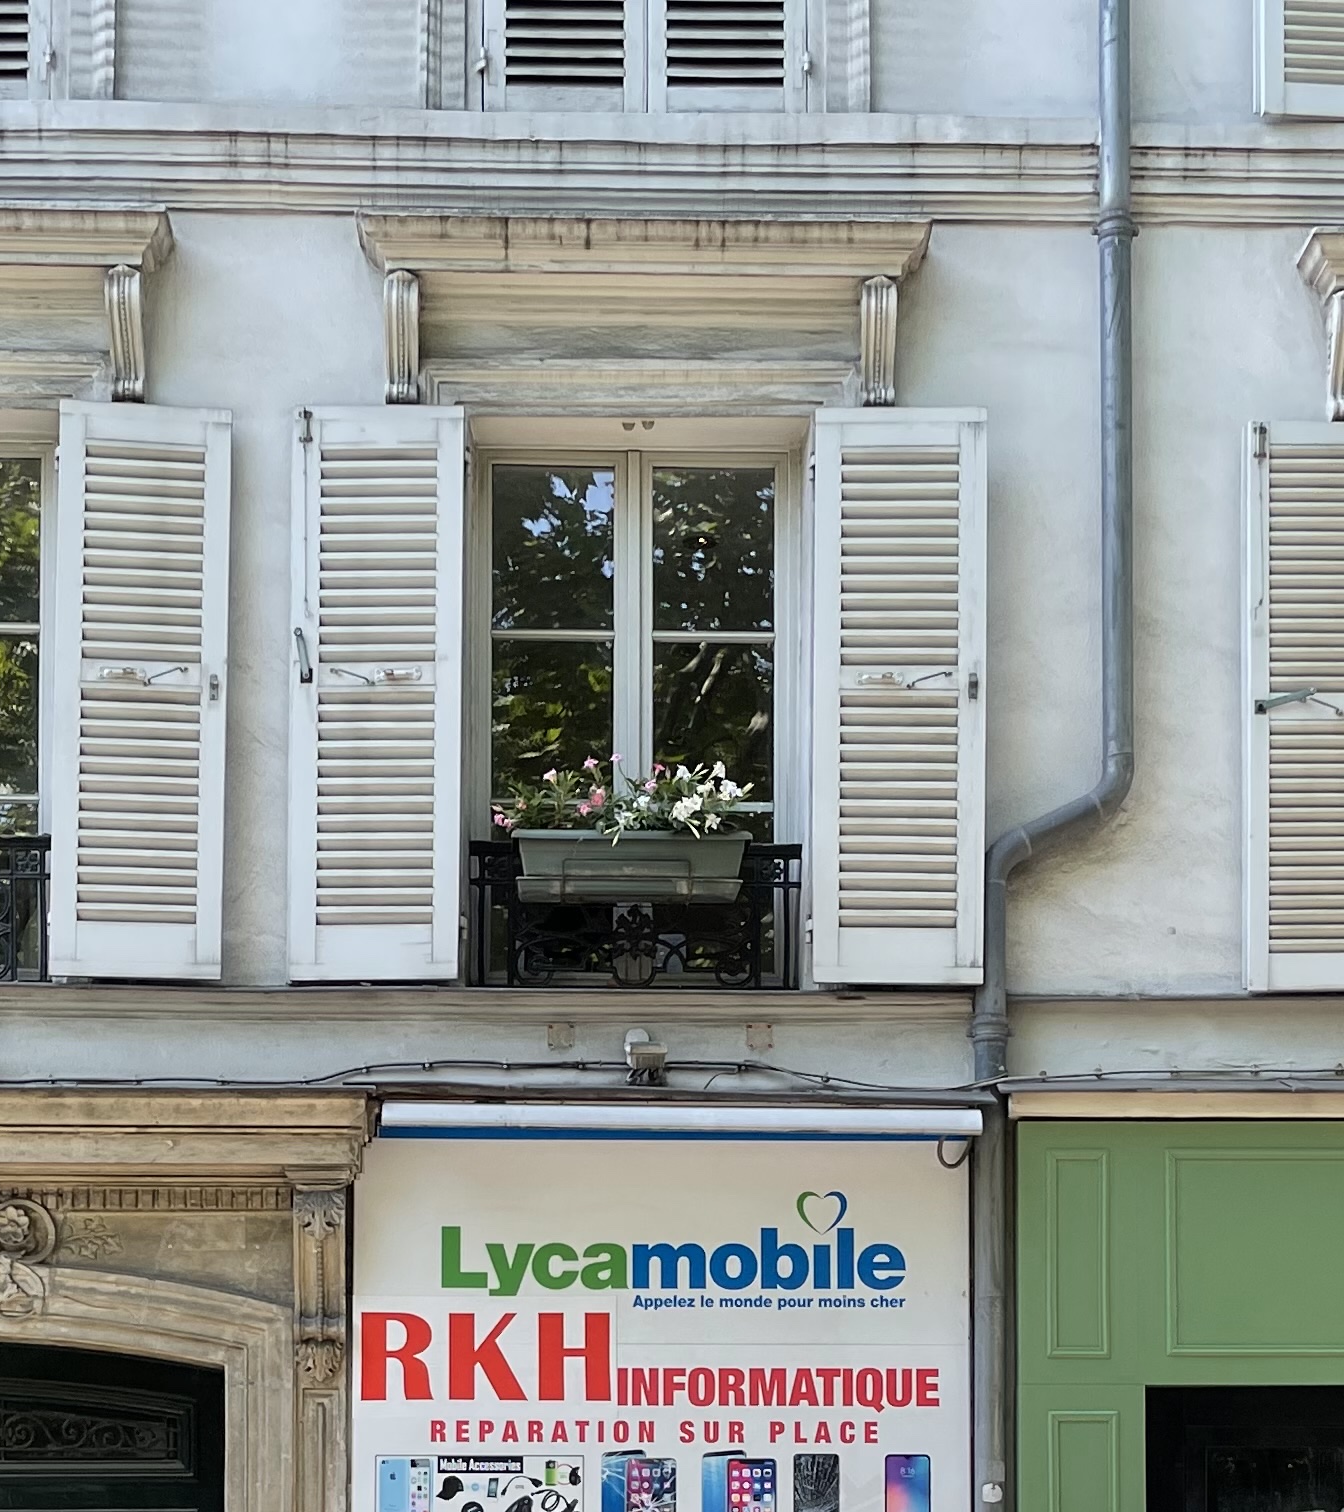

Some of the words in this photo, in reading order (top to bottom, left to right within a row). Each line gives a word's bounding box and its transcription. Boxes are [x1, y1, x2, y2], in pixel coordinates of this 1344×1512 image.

[441, 1226, 906, 1297] Lycamobile
[632, 1295, 695, 1310] Appelez
[700, 1295, 714, 1308] le
[719, 1295, 773, 1308] monde
[777, 1298, 814, 1310] pour
[818, 1295, 866, 1308] moins
[870, 1295, 906, 1308] cher
[361, 1312, 612, 1401] RKH
[617, 1366, 941, 1413] INFORMATIQUE
[430, 1420, 656, 1444] REPARATION
[679, 1420, 746, 1444] SUR
[770, 1420, 881, 1444] PLACE
[440, 1459, 467, 1471] Mobile
